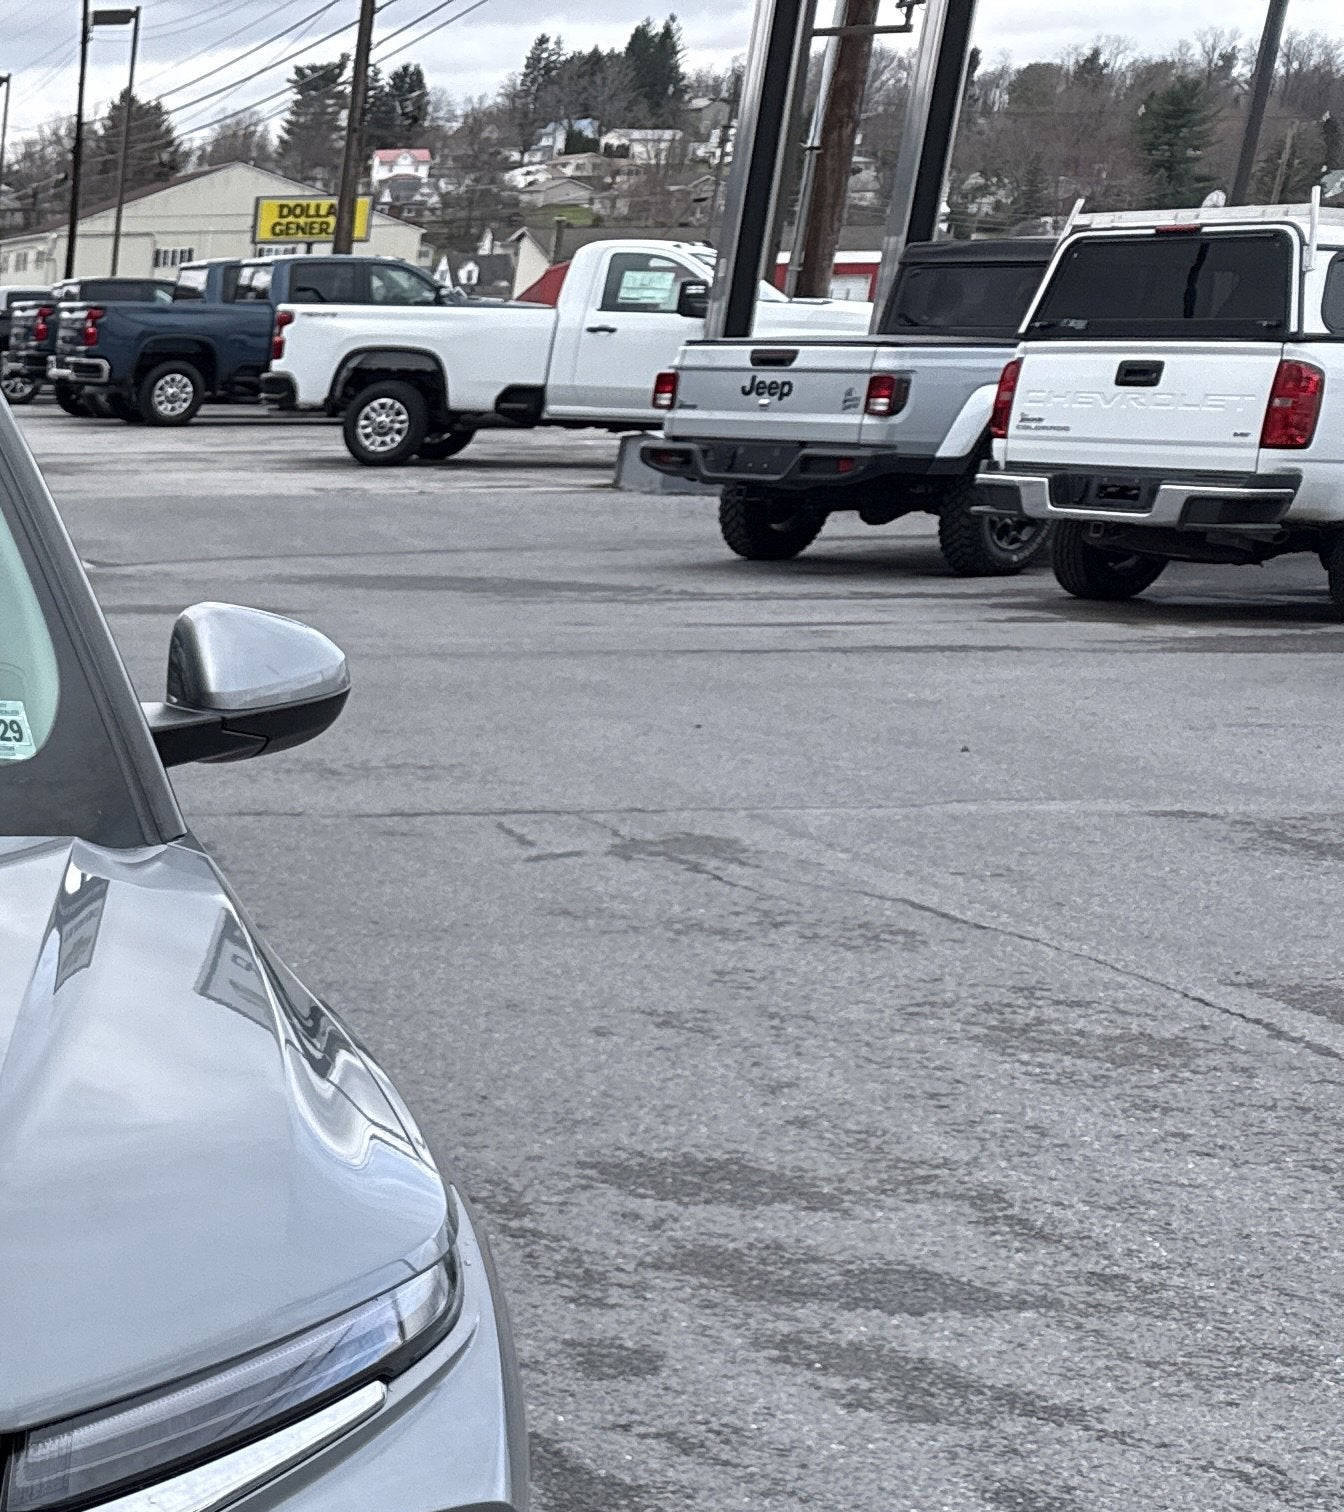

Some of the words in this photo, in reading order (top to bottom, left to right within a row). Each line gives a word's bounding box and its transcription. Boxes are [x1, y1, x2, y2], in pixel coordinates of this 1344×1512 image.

[278, 203, 337, 219] DOLLA
[271, 221, 337, 236] GENER
[741, 374, 794, 401] Jeep
[1023, 389, 1257, 412] CHEVROLET
